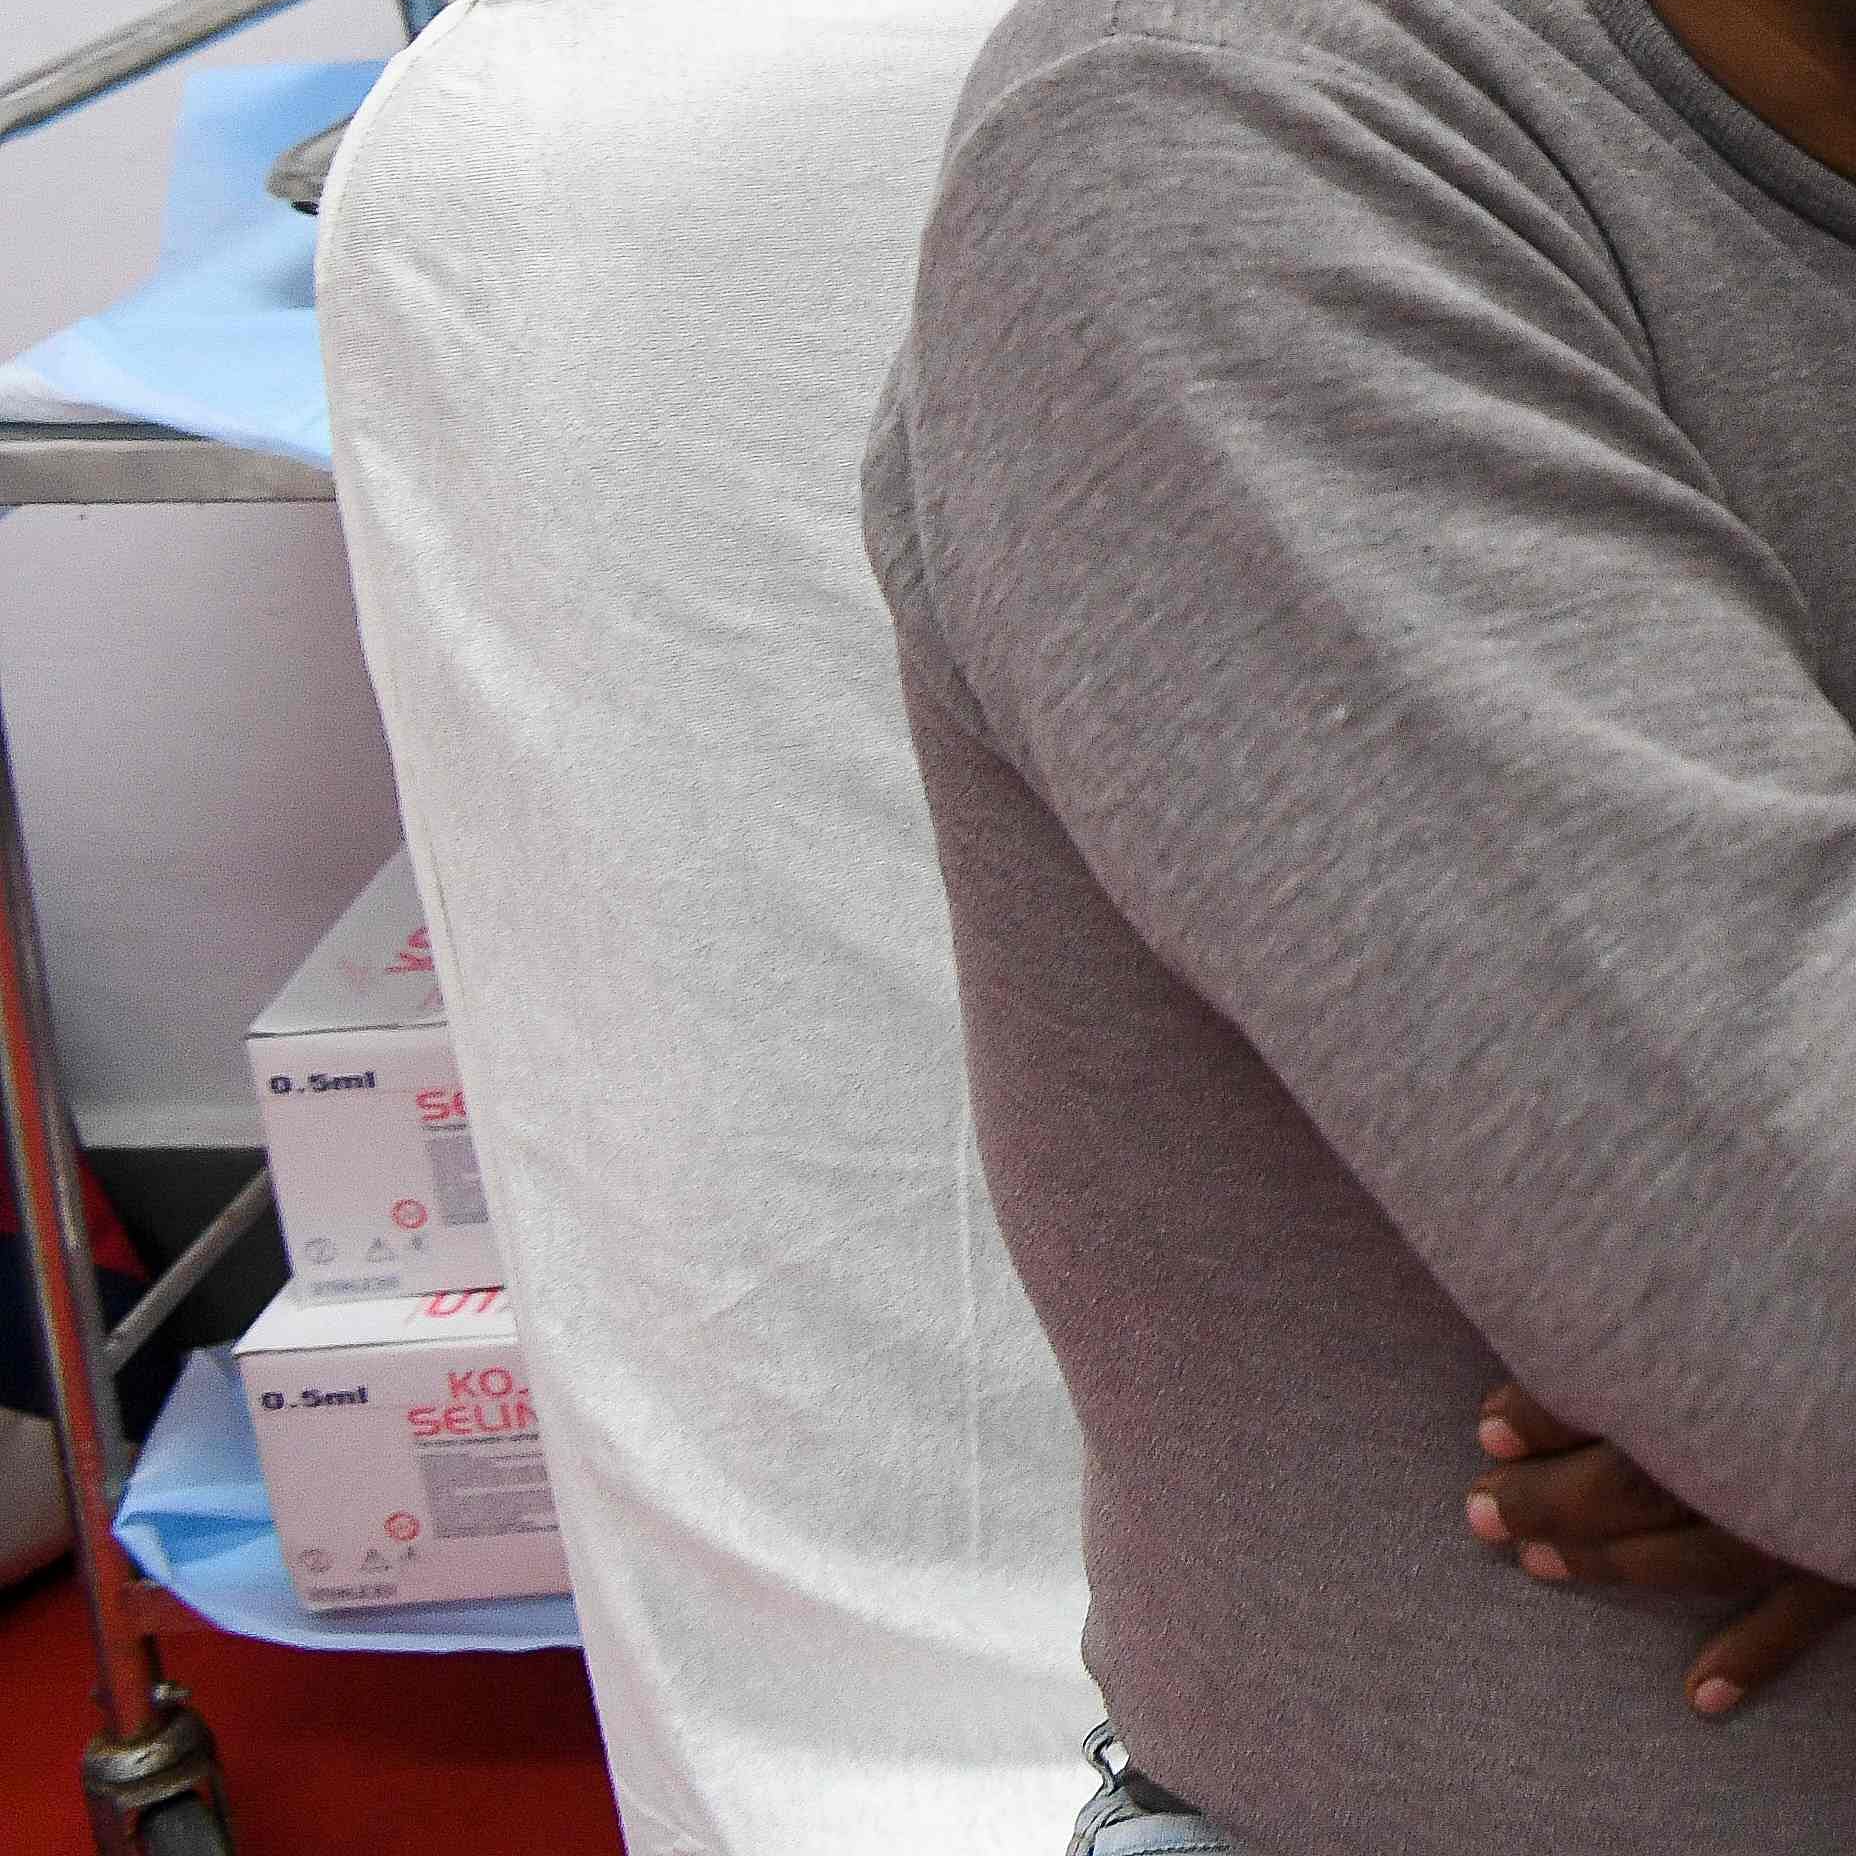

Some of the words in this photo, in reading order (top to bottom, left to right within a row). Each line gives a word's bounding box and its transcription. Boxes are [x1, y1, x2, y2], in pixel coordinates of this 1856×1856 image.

[270, 1071, 376, 1094] 0.5ml
[448, 1366, 530, 1396] KO
[262, 1388, 369, 1410] 0.5ml
